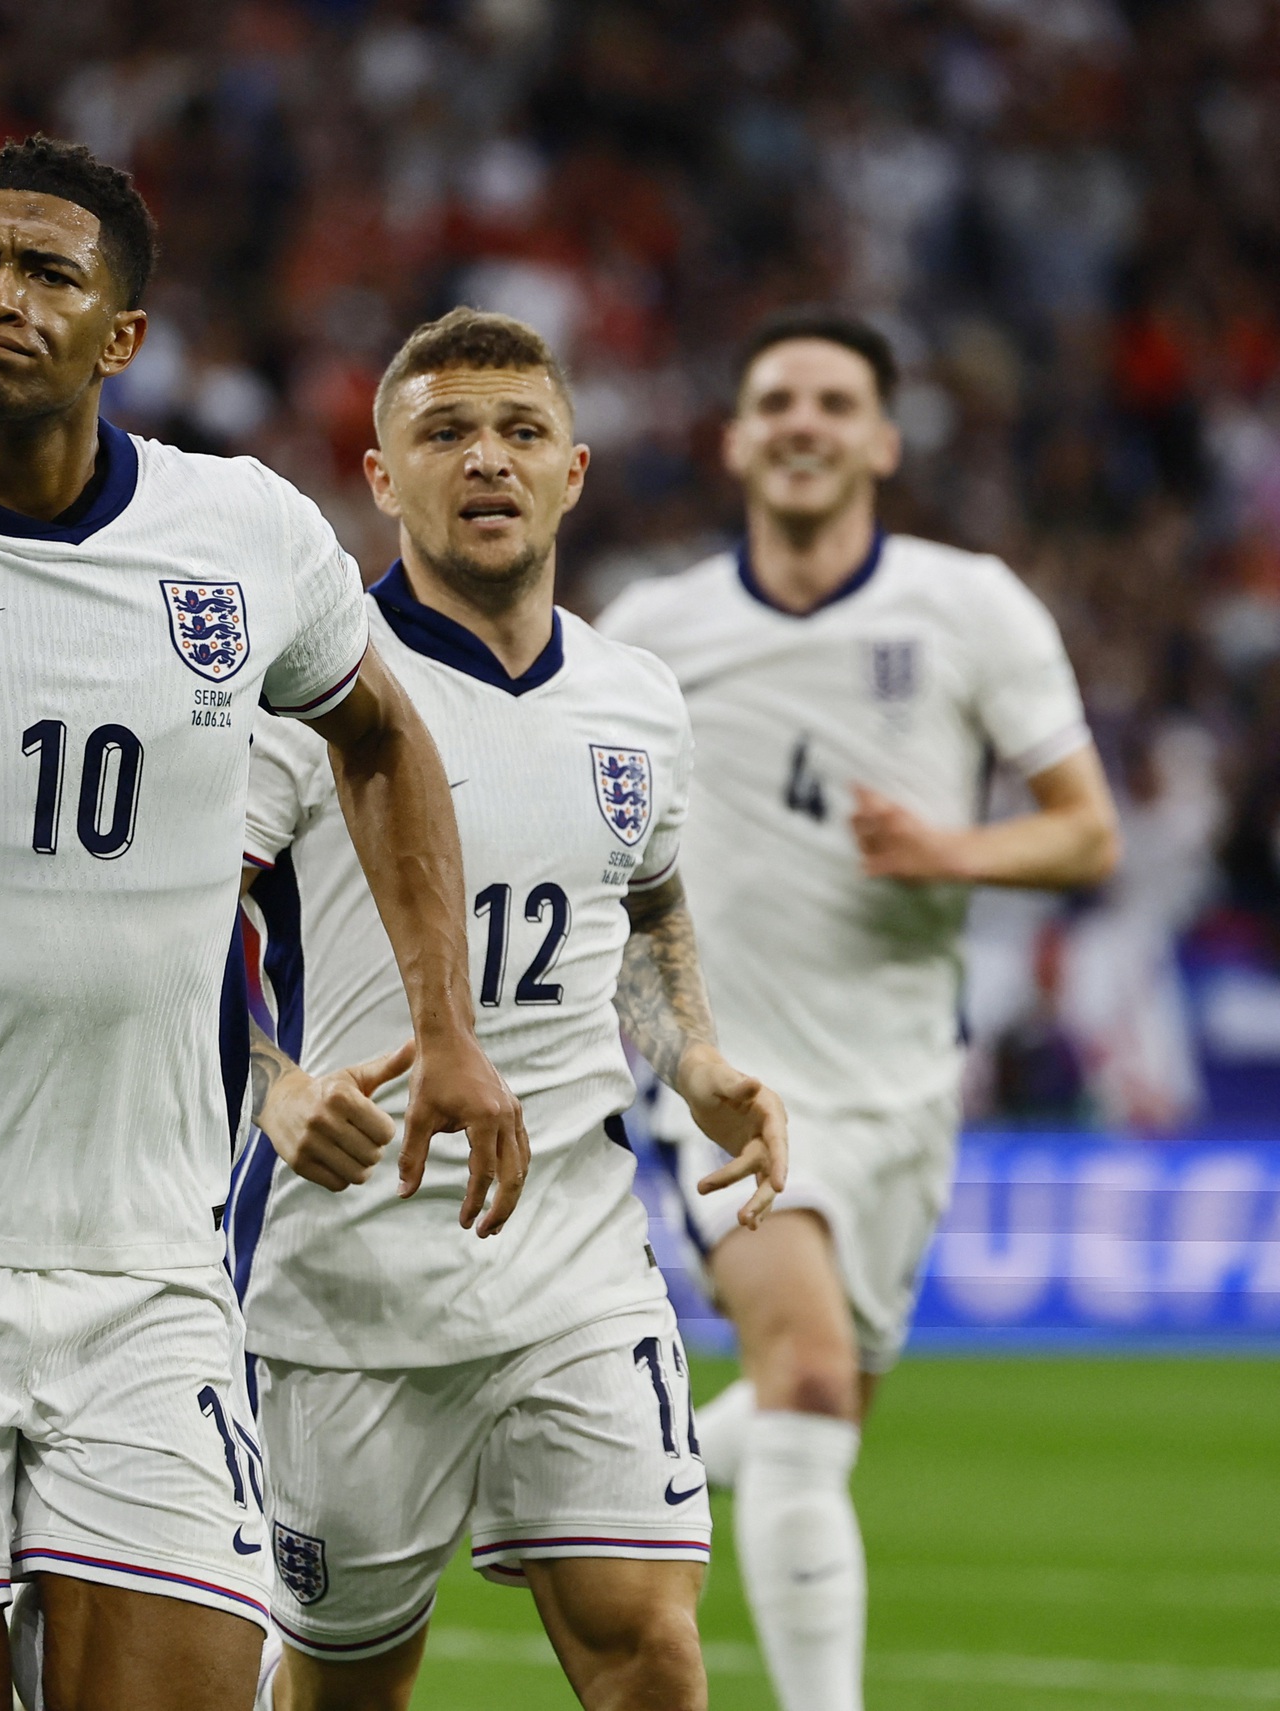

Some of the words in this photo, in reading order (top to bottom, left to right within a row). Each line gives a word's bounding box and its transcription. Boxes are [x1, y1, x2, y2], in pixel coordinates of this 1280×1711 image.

[191, 710, 232, 728] 16.06.24
[194, 689, 232, 707] SERBIA
[21, 719, 144, 860] 10
[783, 730, 828, 824] 4
[474, 882, 571, 1007] 12
[933, 1147, 1280, 1322] UEF
